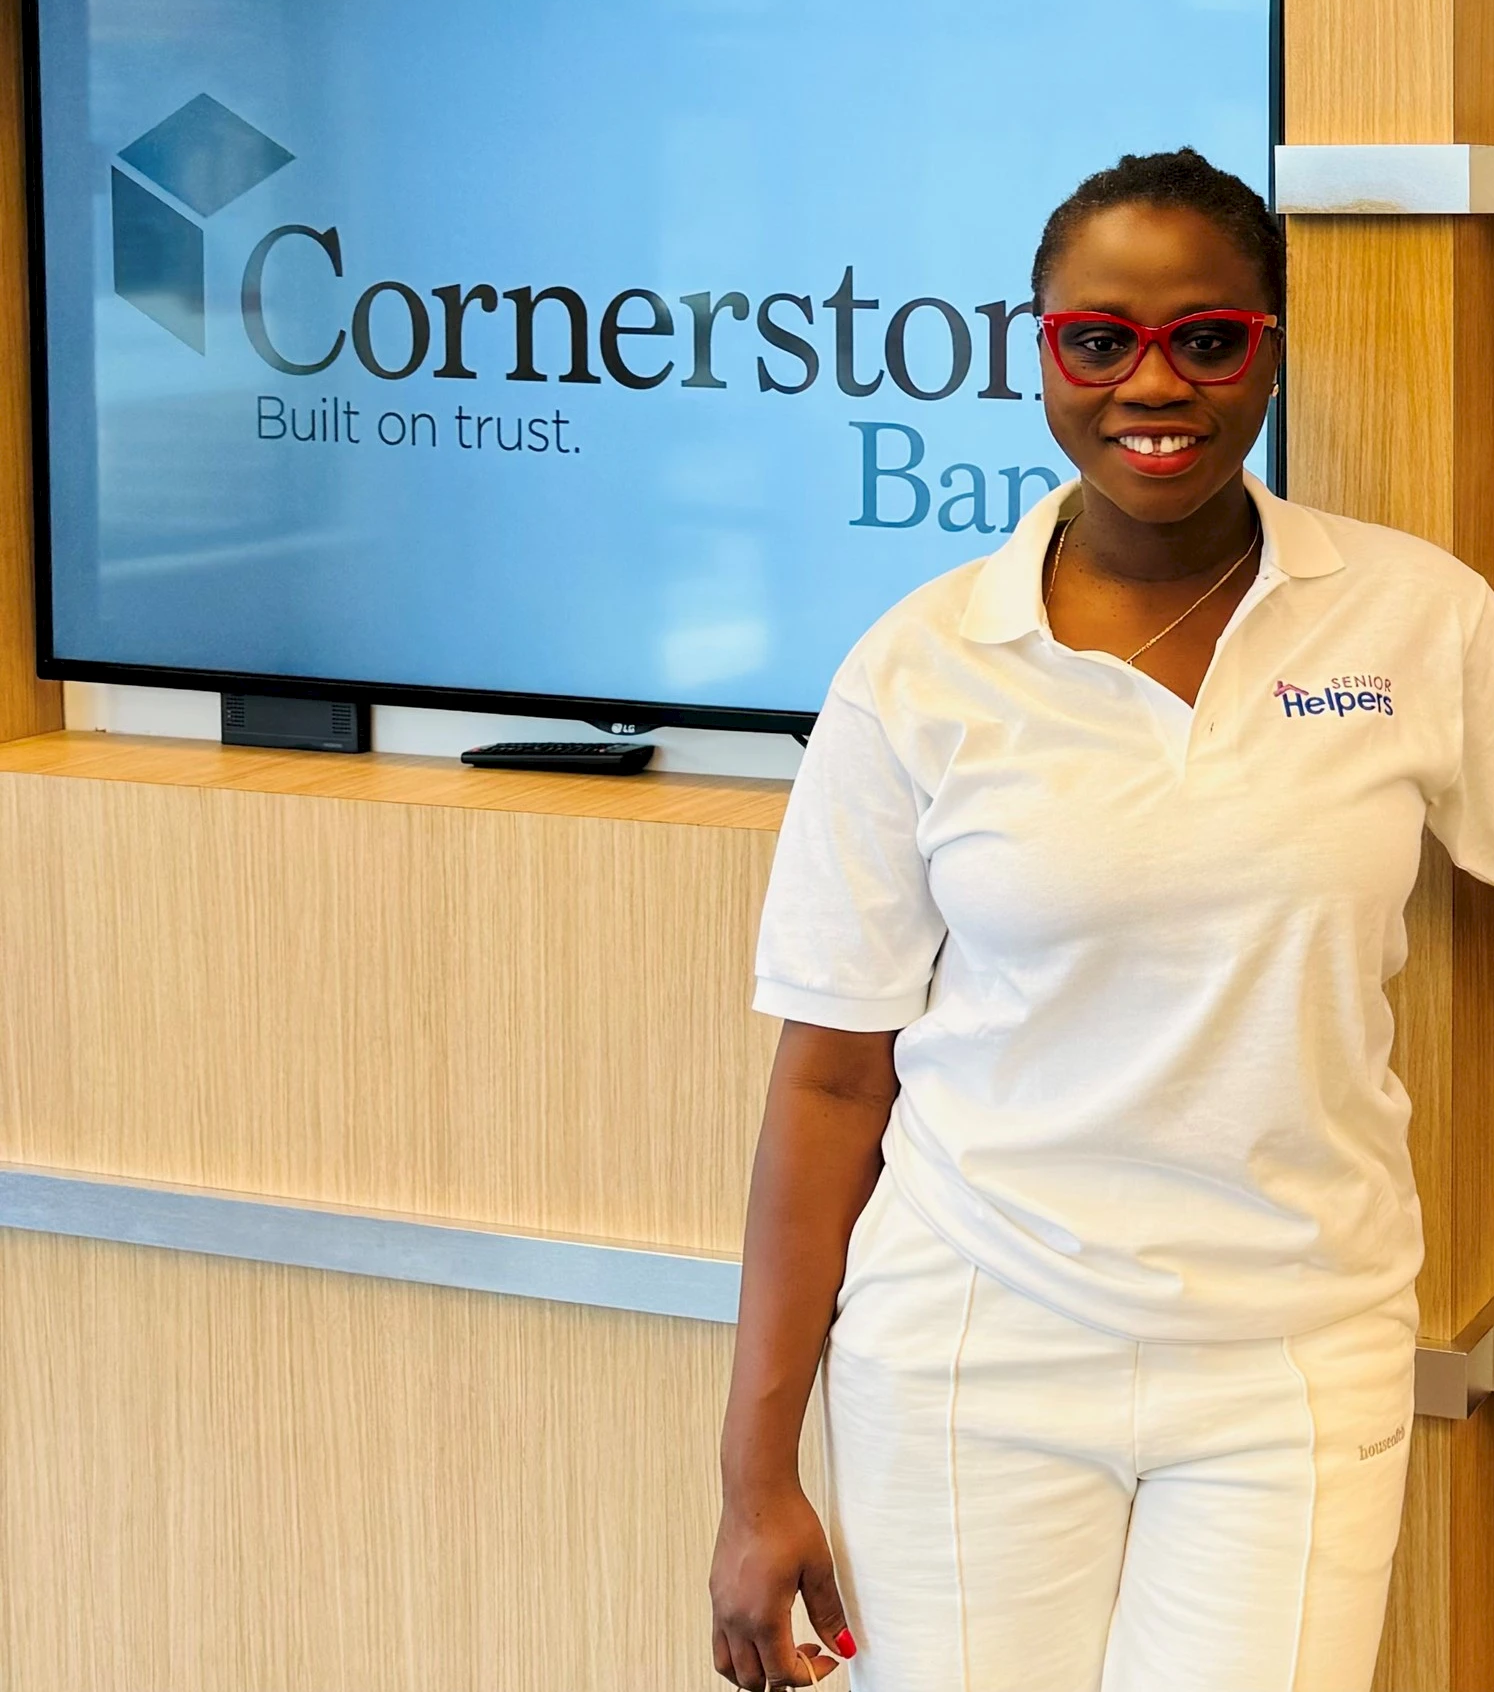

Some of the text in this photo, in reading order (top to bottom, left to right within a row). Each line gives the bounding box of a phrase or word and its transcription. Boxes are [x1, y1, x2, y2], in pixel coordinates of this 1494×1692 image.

[241, 224, 1044, 401] Cornerston
[257, 395, 580, 454] Built on trust.
[849, 420, 1061, 534] Ban
[1282, 687, 1393, 717] Helpers
[1331, 674, 1392, 693] SENIOR
[623, 724, 636, 733] LG
